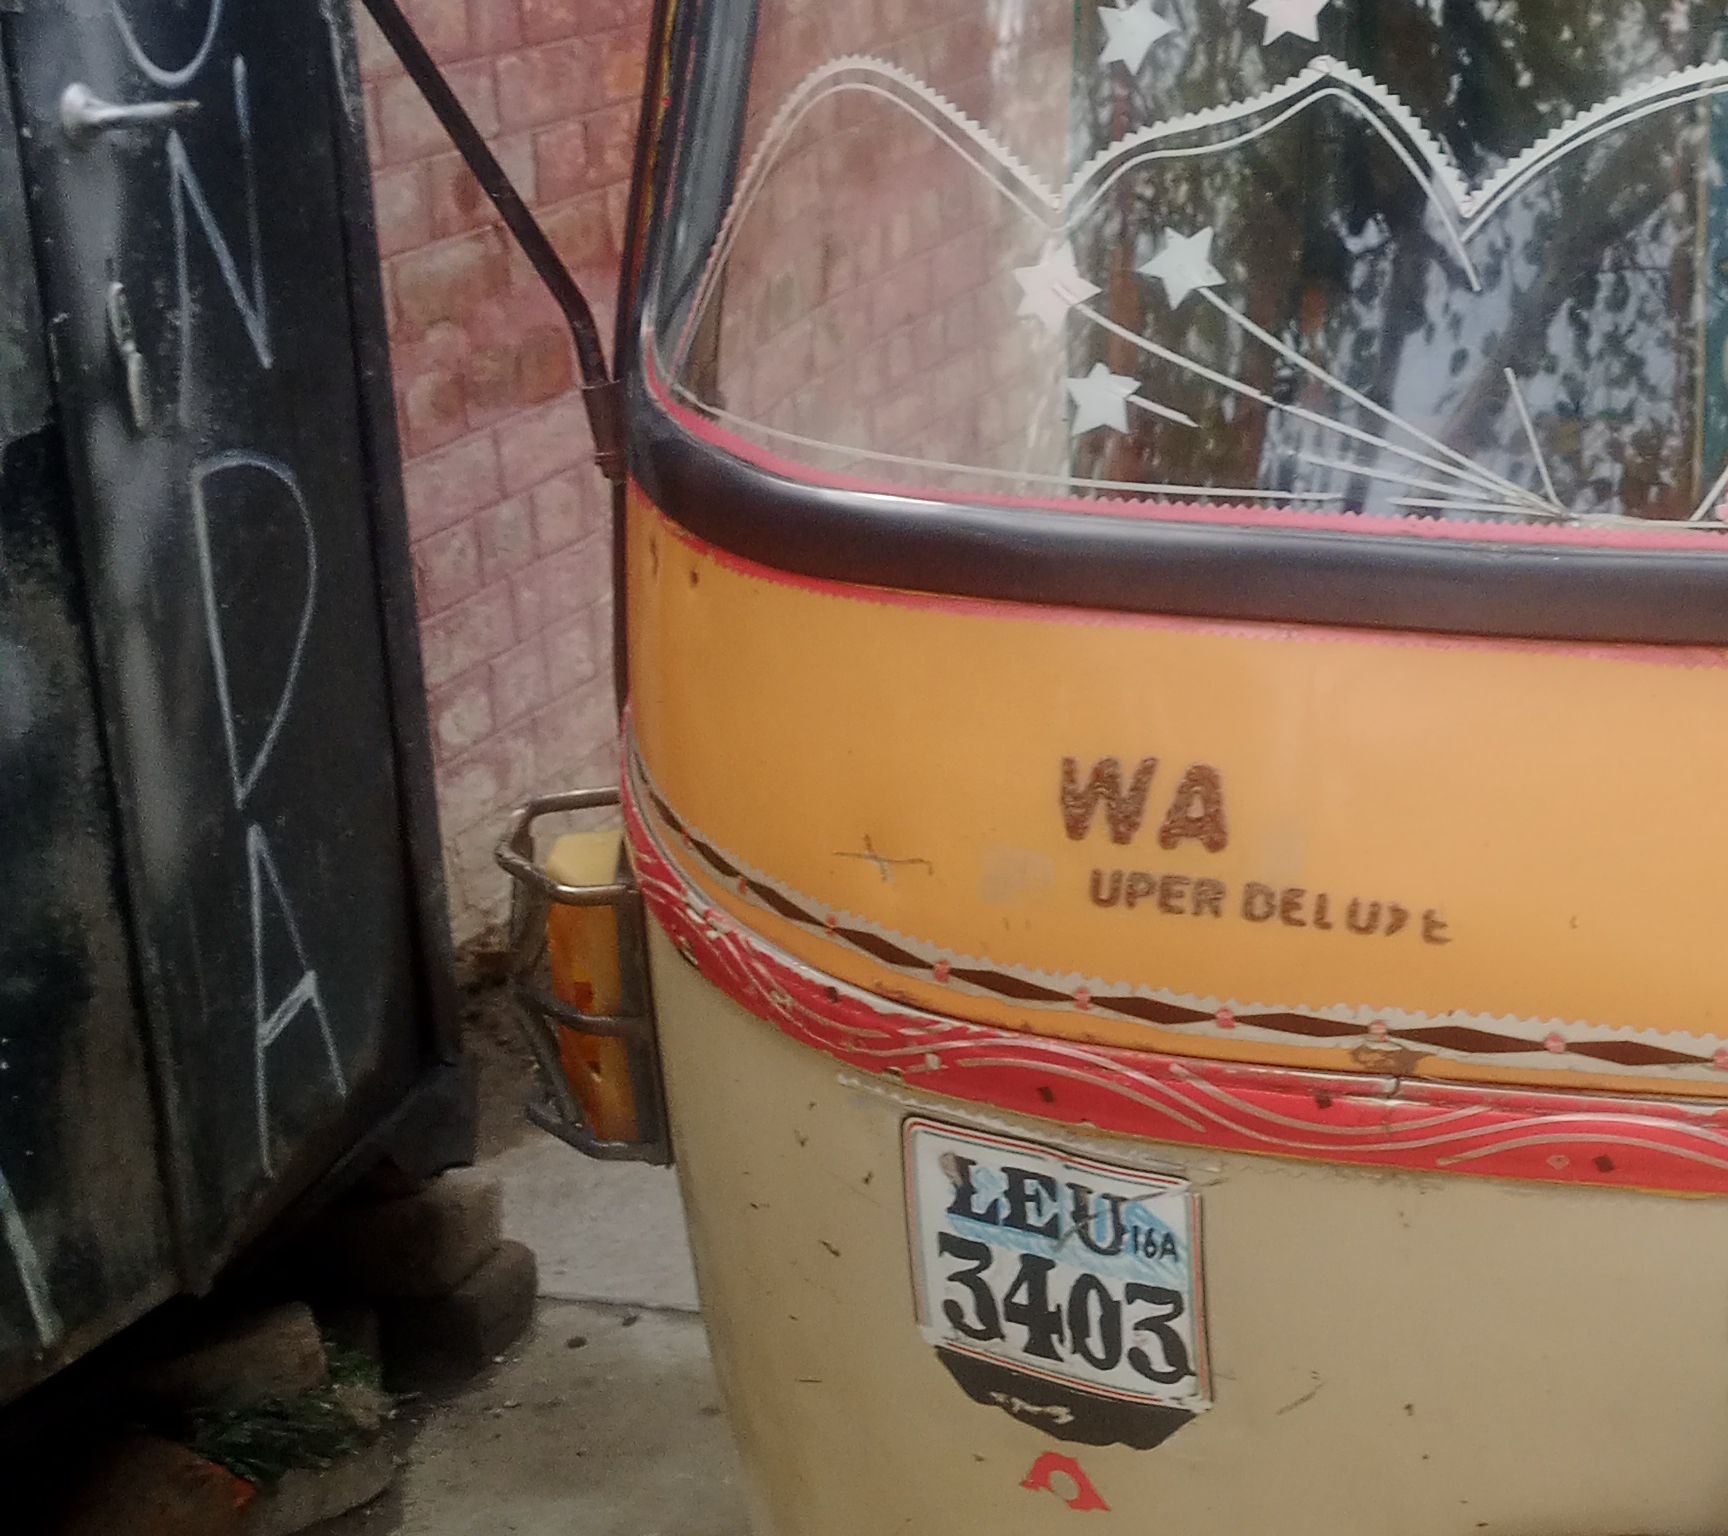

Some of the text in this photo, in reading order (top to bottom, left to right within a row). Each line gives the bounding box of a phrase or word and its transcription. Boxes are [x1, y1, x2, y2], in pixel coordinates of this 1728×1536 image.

[939, 1152, 1179, 1262] LEU 16A
[937, 1230, 1197, 1386] 3403
